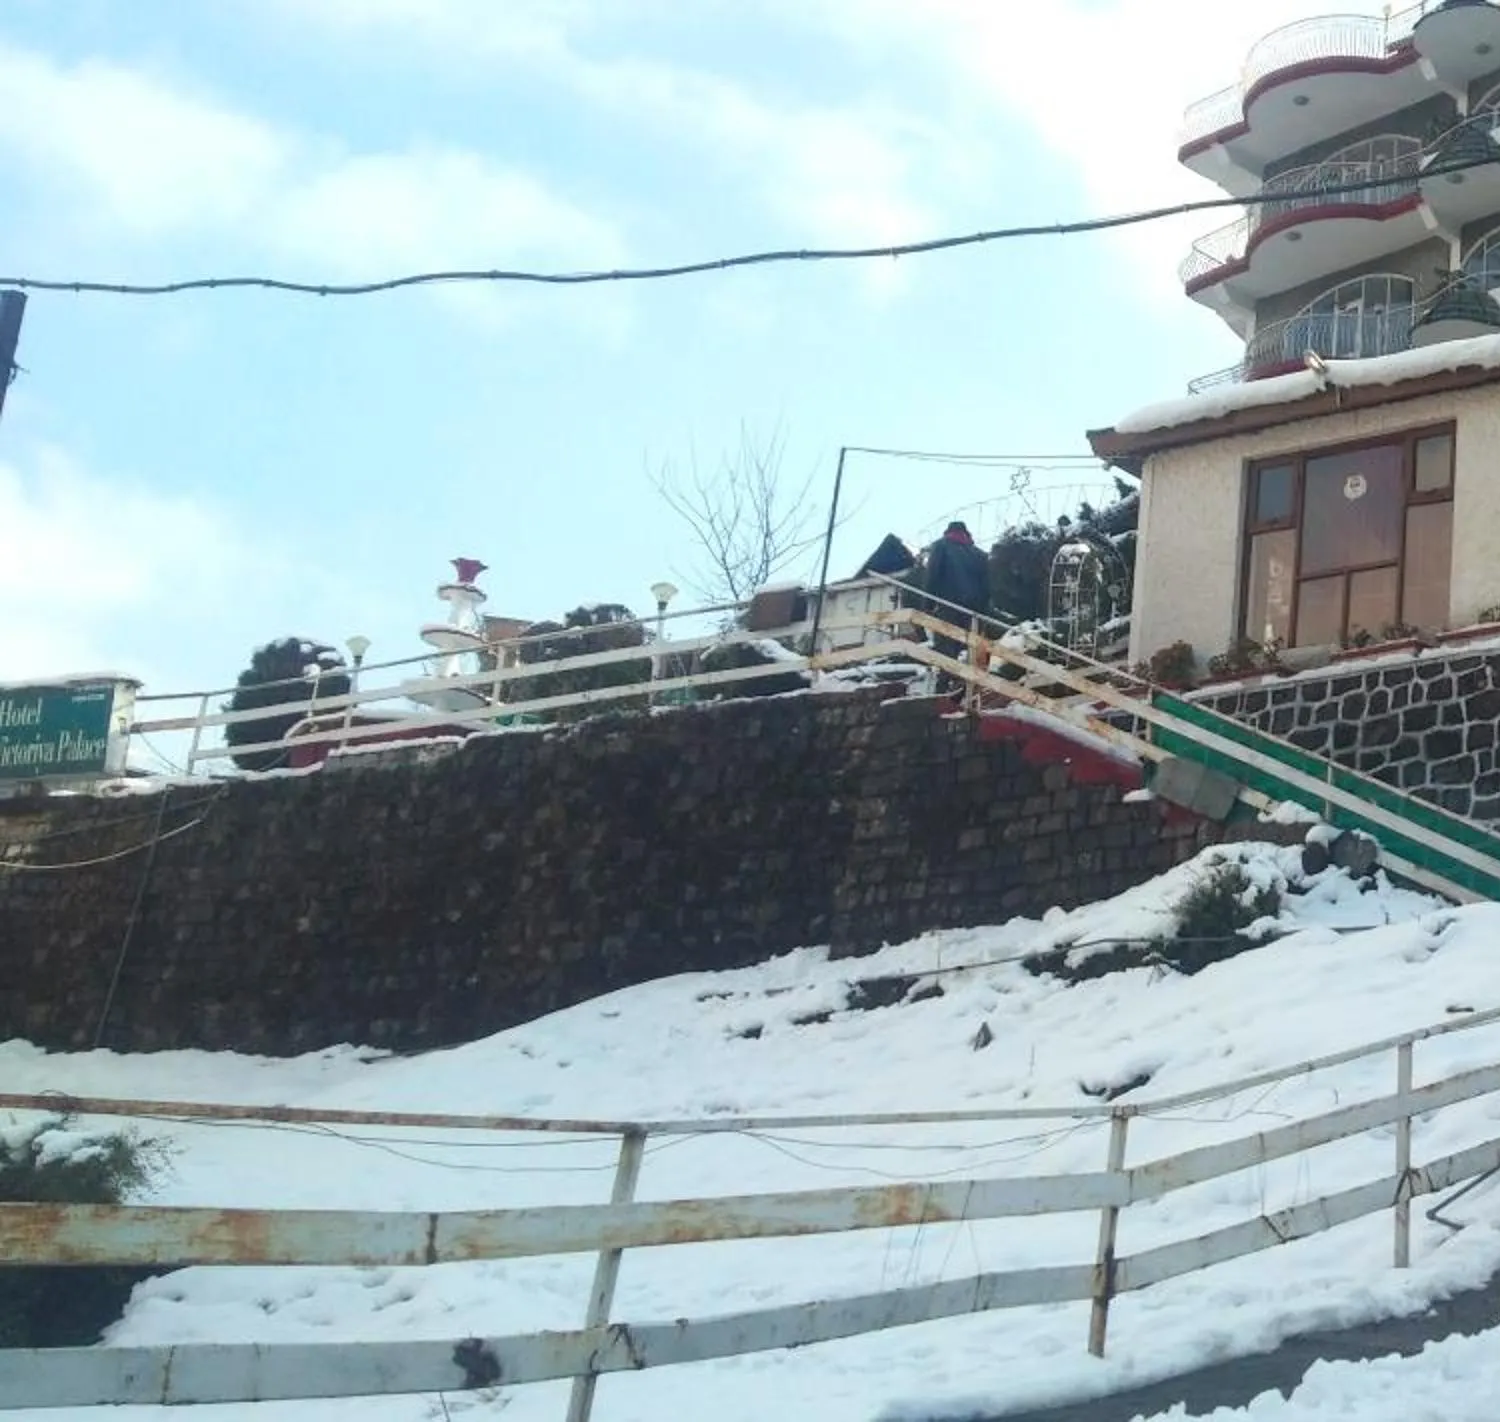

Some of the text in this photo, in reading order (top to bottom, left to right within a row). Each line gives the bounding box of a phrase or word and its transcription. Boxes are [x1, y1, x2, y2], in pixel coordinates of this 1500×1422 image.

[0, 698, 43, 727] Hotel
[0, 729, 105, 775] ictoriya Palace
